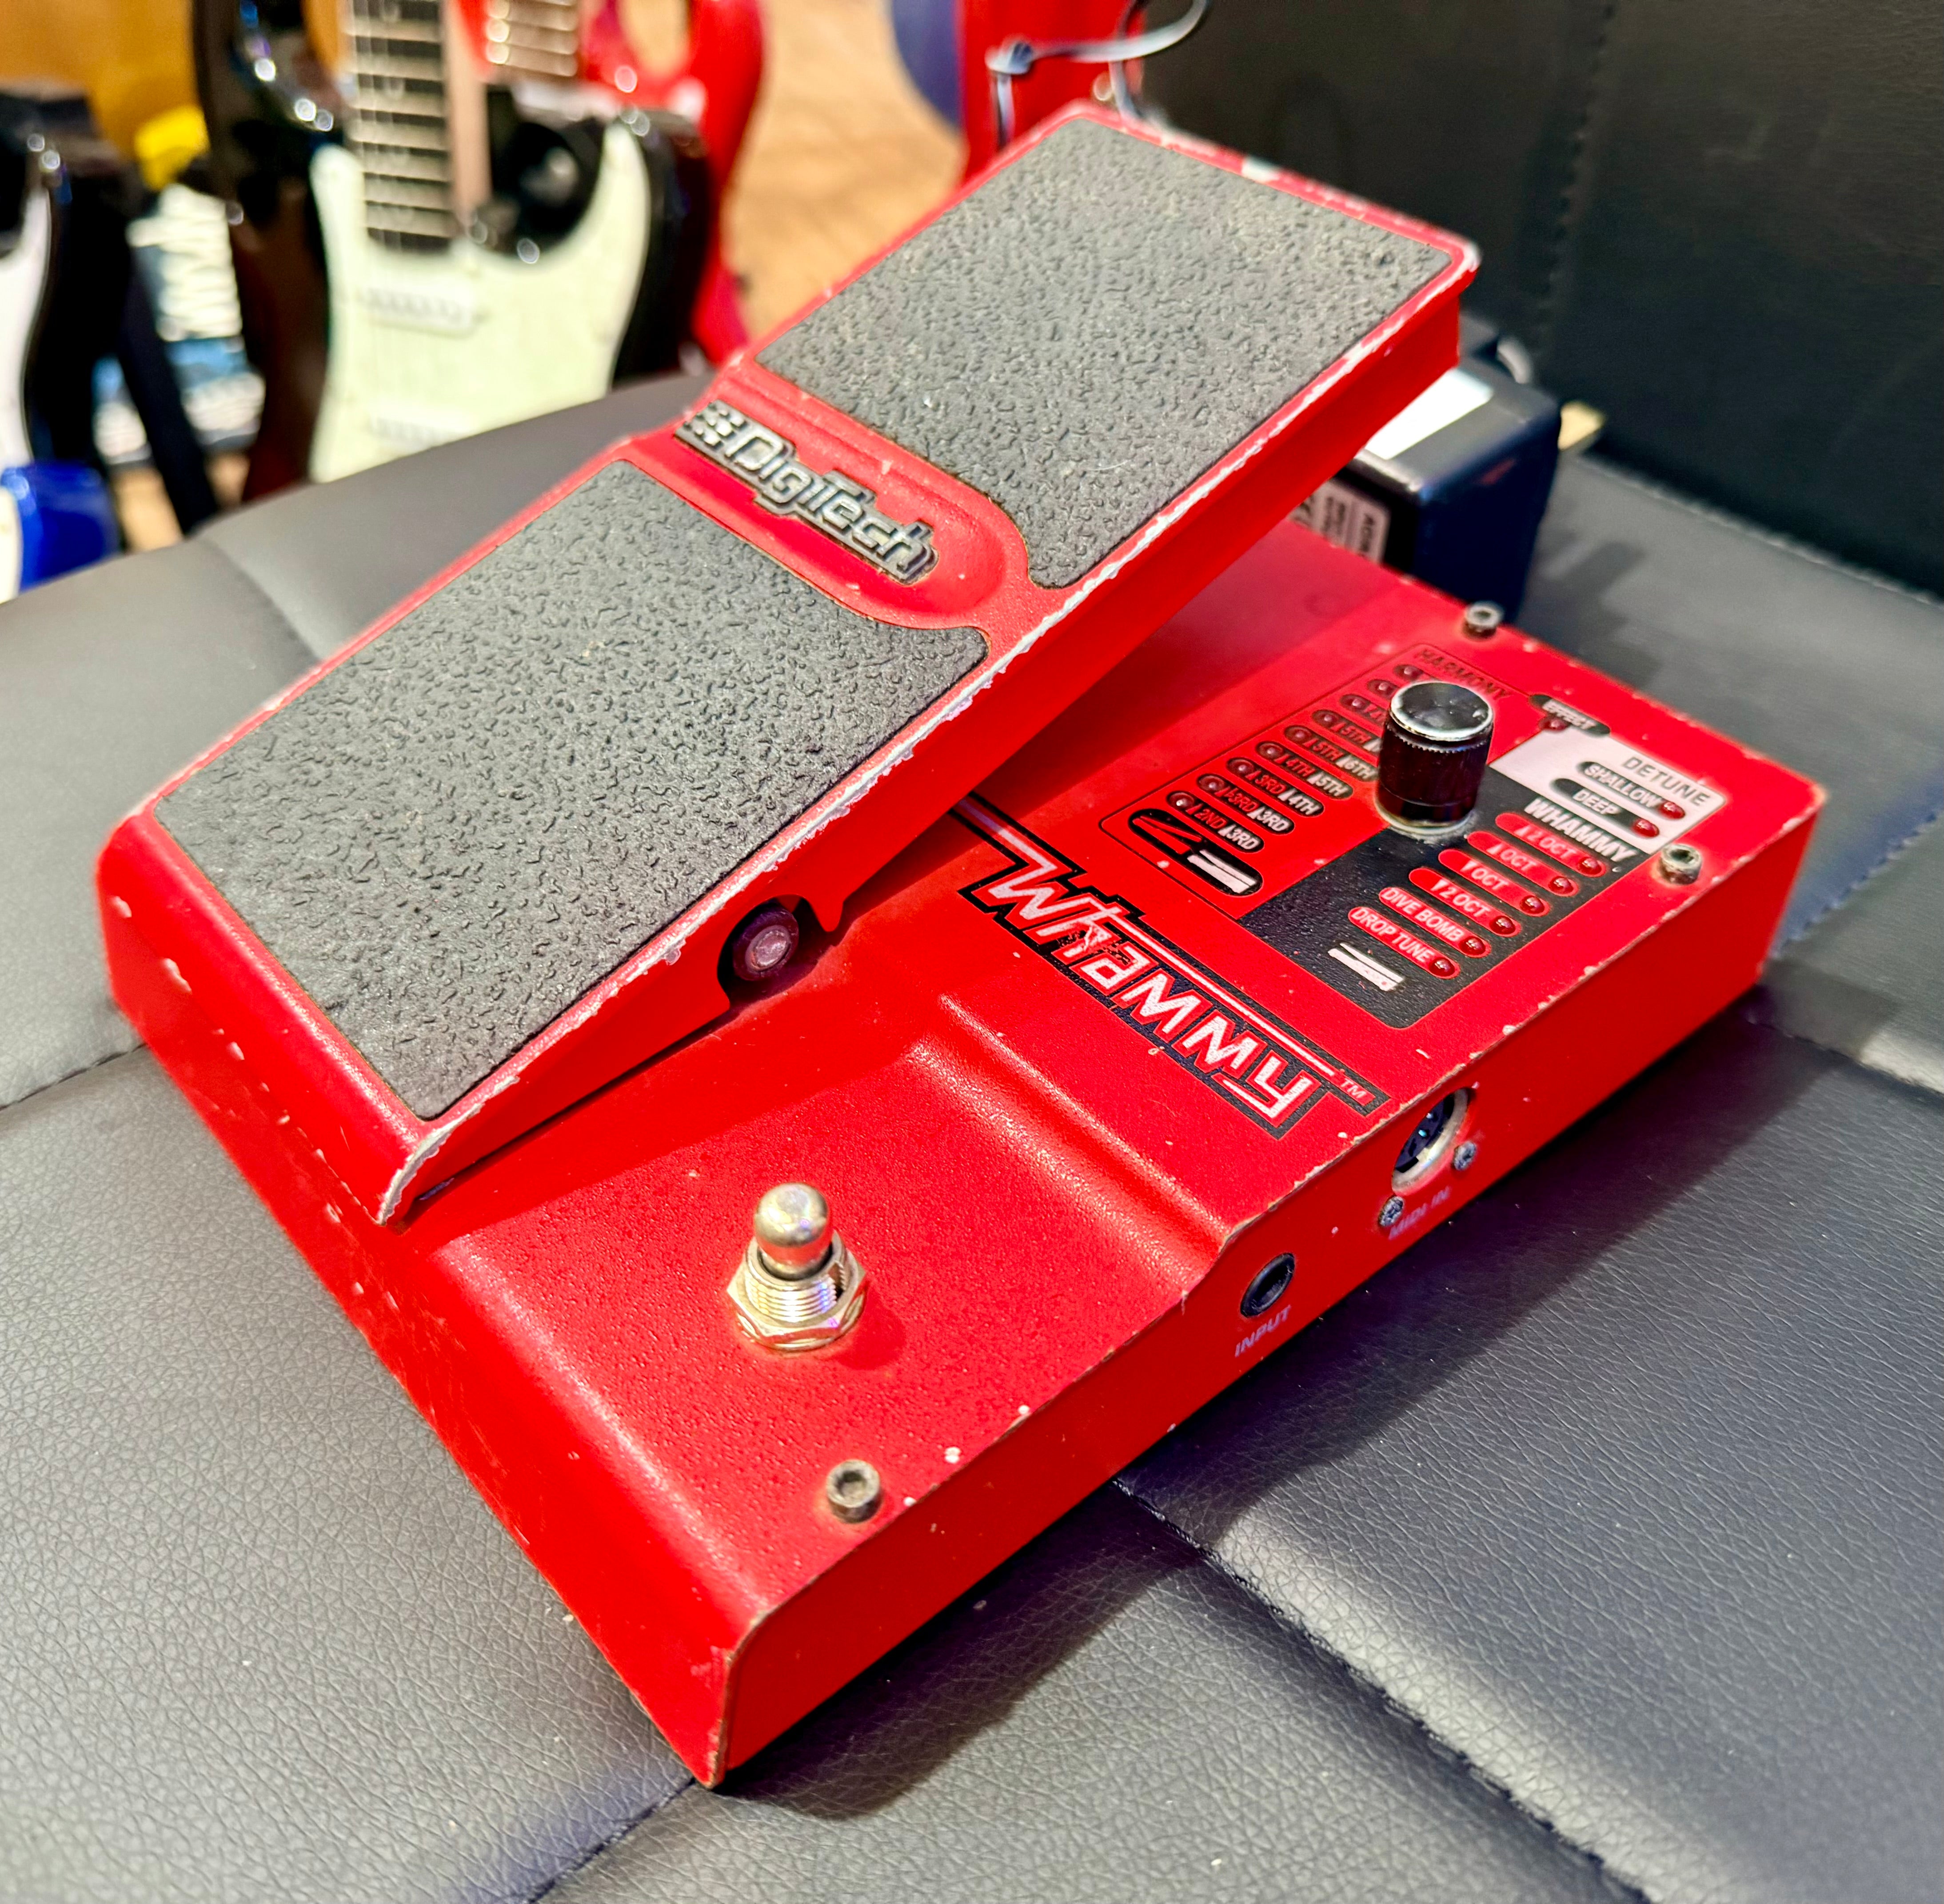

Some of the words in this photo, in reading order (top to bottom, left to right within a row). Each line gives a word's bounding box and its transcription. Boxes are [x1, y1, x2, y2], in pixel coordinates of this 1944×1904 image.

[1414, 649, 1512, 700] HARMONY
[1542, 699, 1597, 730] EFFECT
[1341, 725, 1372, 744] 5TH
[1286, 758, 1315, 777] 4TH
[1315, 776, 1348, 796] 5TH
[1313, 741, 1344, 760] 5TH
[1346, 756, 1377, 779] 6TH
[1255, 775, 1287, 794] 3RD
[1289, 795, 1320, 815] 4TH
[1585, 765, 1663, 808] SHALLOW
[1622, 756, 1710, 807] DETUNE
[1257, 809, 1289, 832] 3RD
[1573, 789, 1621, 816] DEEP
[1194, 809, 1226, 829] 2ND
[1226, 824, 1260, 850] 3RD
[1524, 797, 1638, 862] WHAMMY
[1527, 829, 1541, 841] 2
[1539, 837, 1577, 860] OCT
[1471, 867, 1509, 890] OCT
[1501, 850, 1538, 872] OCT
[1381, 888, 1421, 914] DIVE
[1415, 908, 1465, 943] BOMB
[1441, 886, 1454, 899] 2
[1452, 894, 1491, 918] OCT
[1351, 907, 1396, 935] DROP
[1391, 933, 1435, 962] TUNE
[1341, 1078, 1368, 1100] TM
[1234, 1305, 1291, 1357] INPUT
